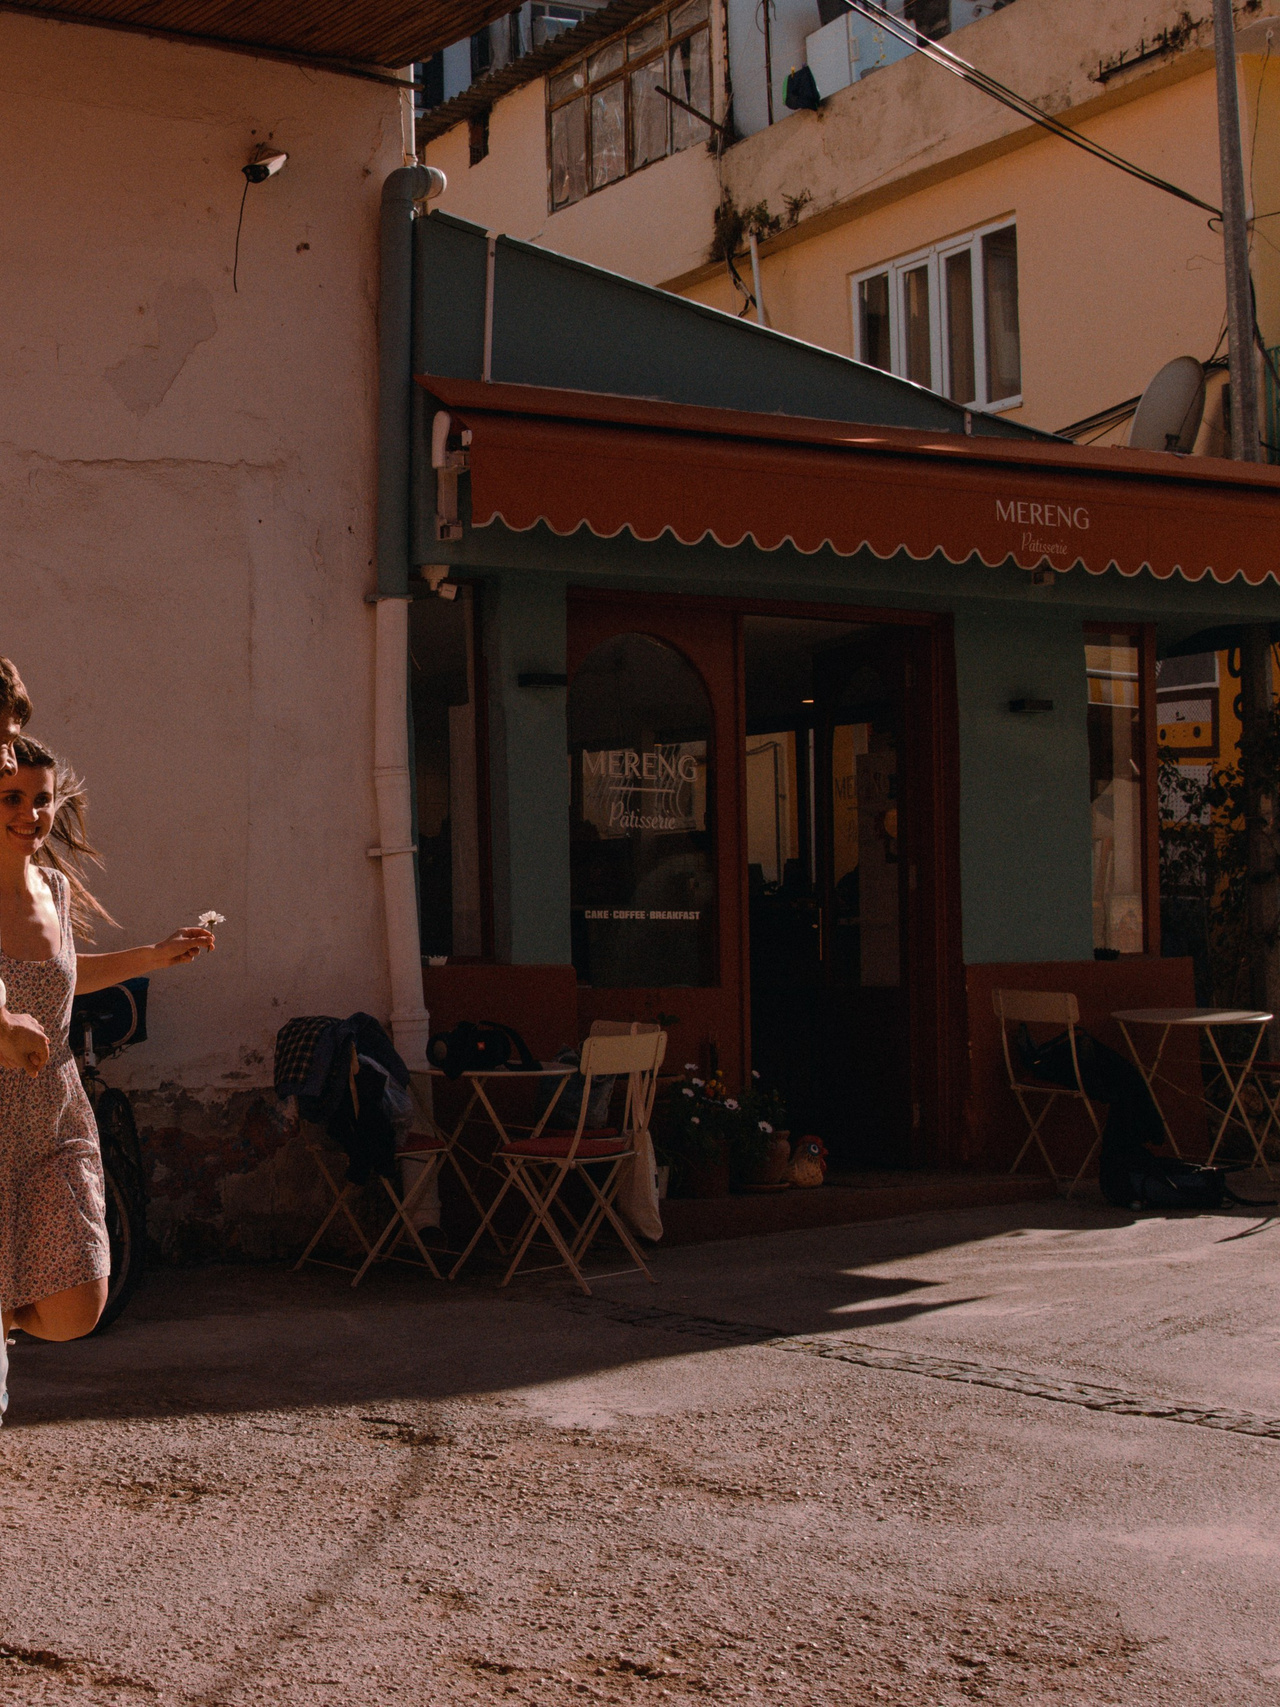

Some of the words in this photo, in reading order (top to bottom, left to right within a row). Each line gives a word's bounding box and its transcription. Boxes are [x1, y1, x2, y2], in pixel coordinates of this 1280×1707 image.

[996, 500, 1089, 530] MERENG
[583, 749, 698, 783] MERENG
[585, 910, 609, 919] CAKE
[613, 910, 646, 920] COFFEE
[650, 911, 700, 920] BREAKFAST
